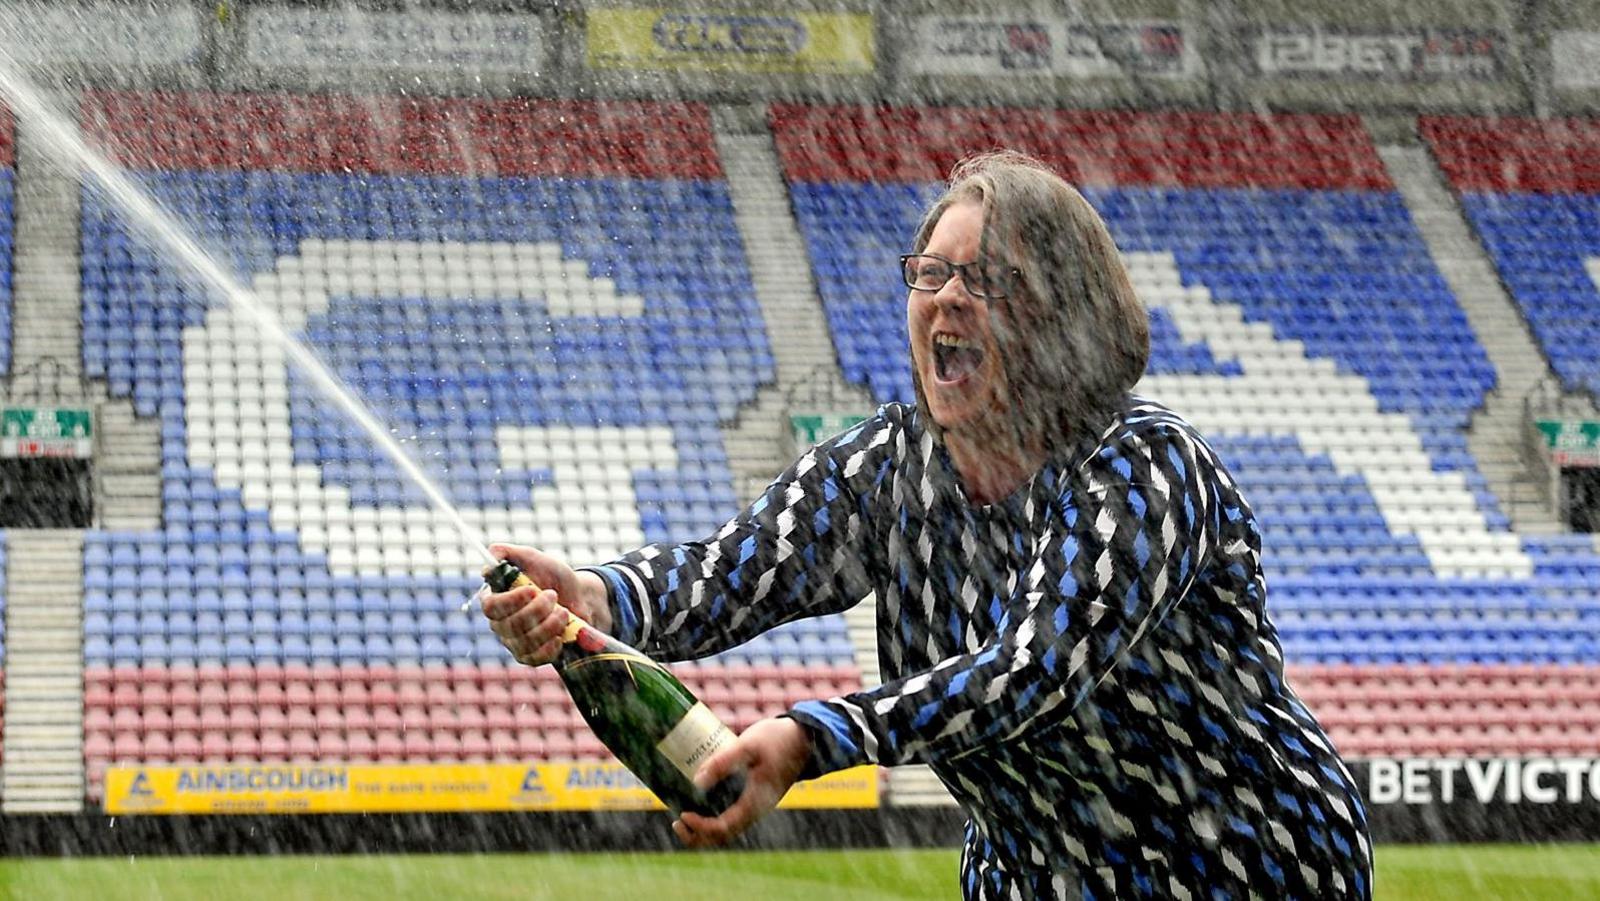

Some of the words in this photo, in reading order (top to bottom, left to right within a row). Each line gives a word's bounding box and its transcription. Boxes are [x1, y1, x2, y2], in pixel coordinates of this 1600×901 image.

[177, 770, 348, 792] AINSCOUGH
[566, 767, 645, 789] AINS
[1369, 758, 1600, 804] BETVICT
